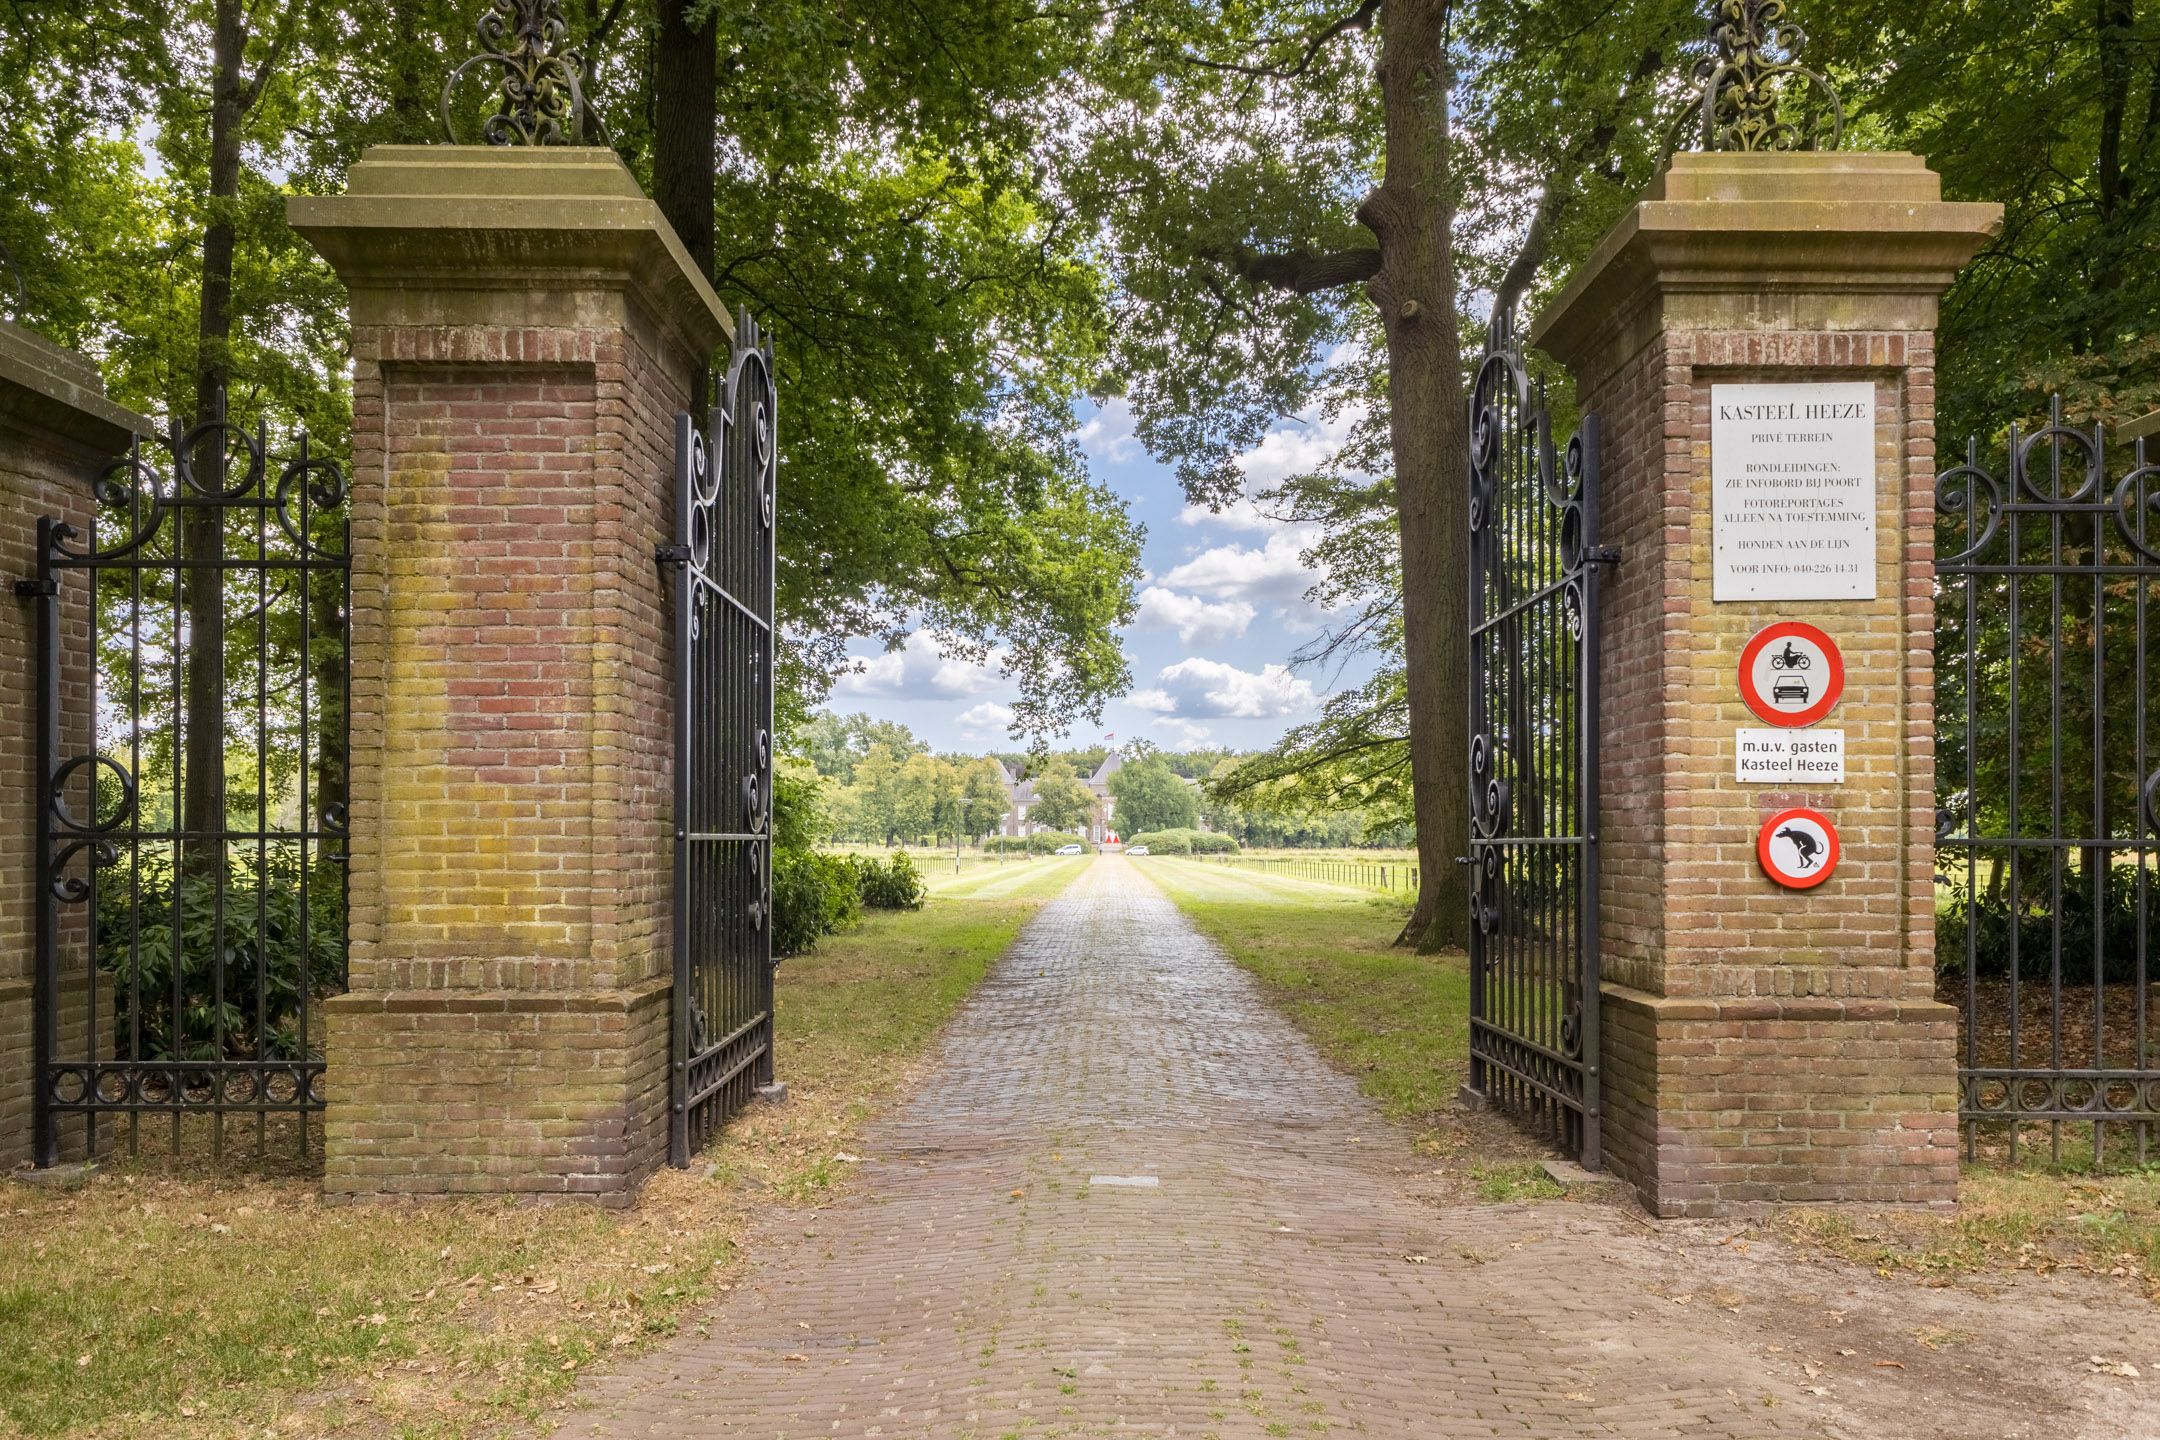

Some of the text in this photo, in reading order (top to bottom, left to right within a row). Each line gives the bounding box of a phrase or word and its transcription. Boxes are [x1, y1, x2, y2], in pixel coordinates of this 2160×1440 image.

[1720, 403, 1866, 421] KASTEEL HEEZE
[1751, 432, 1833, 443] PRIVÉ TERREIN
[1746, 462, 1841, 473] RONDLEIDINGEN:
[1725, 477, 1862, 488] ZIE INFOBORD BIJ POORT
[1744, 498, 1844, 508] FOTOREPORTAGES
[1723, 512, 1866, 523] ALLEEN NA TOESTEMMING
[1738, 539, 1850, 549] HONDEN AAN DE LIJN
[1730, 563, 1858, 573] VOOR INFO: 040-226 14 31
[1743, 741, 1837, 755] m.u.v. gasten
[1741, 758, 1839, 772] Kasteel Heeze
